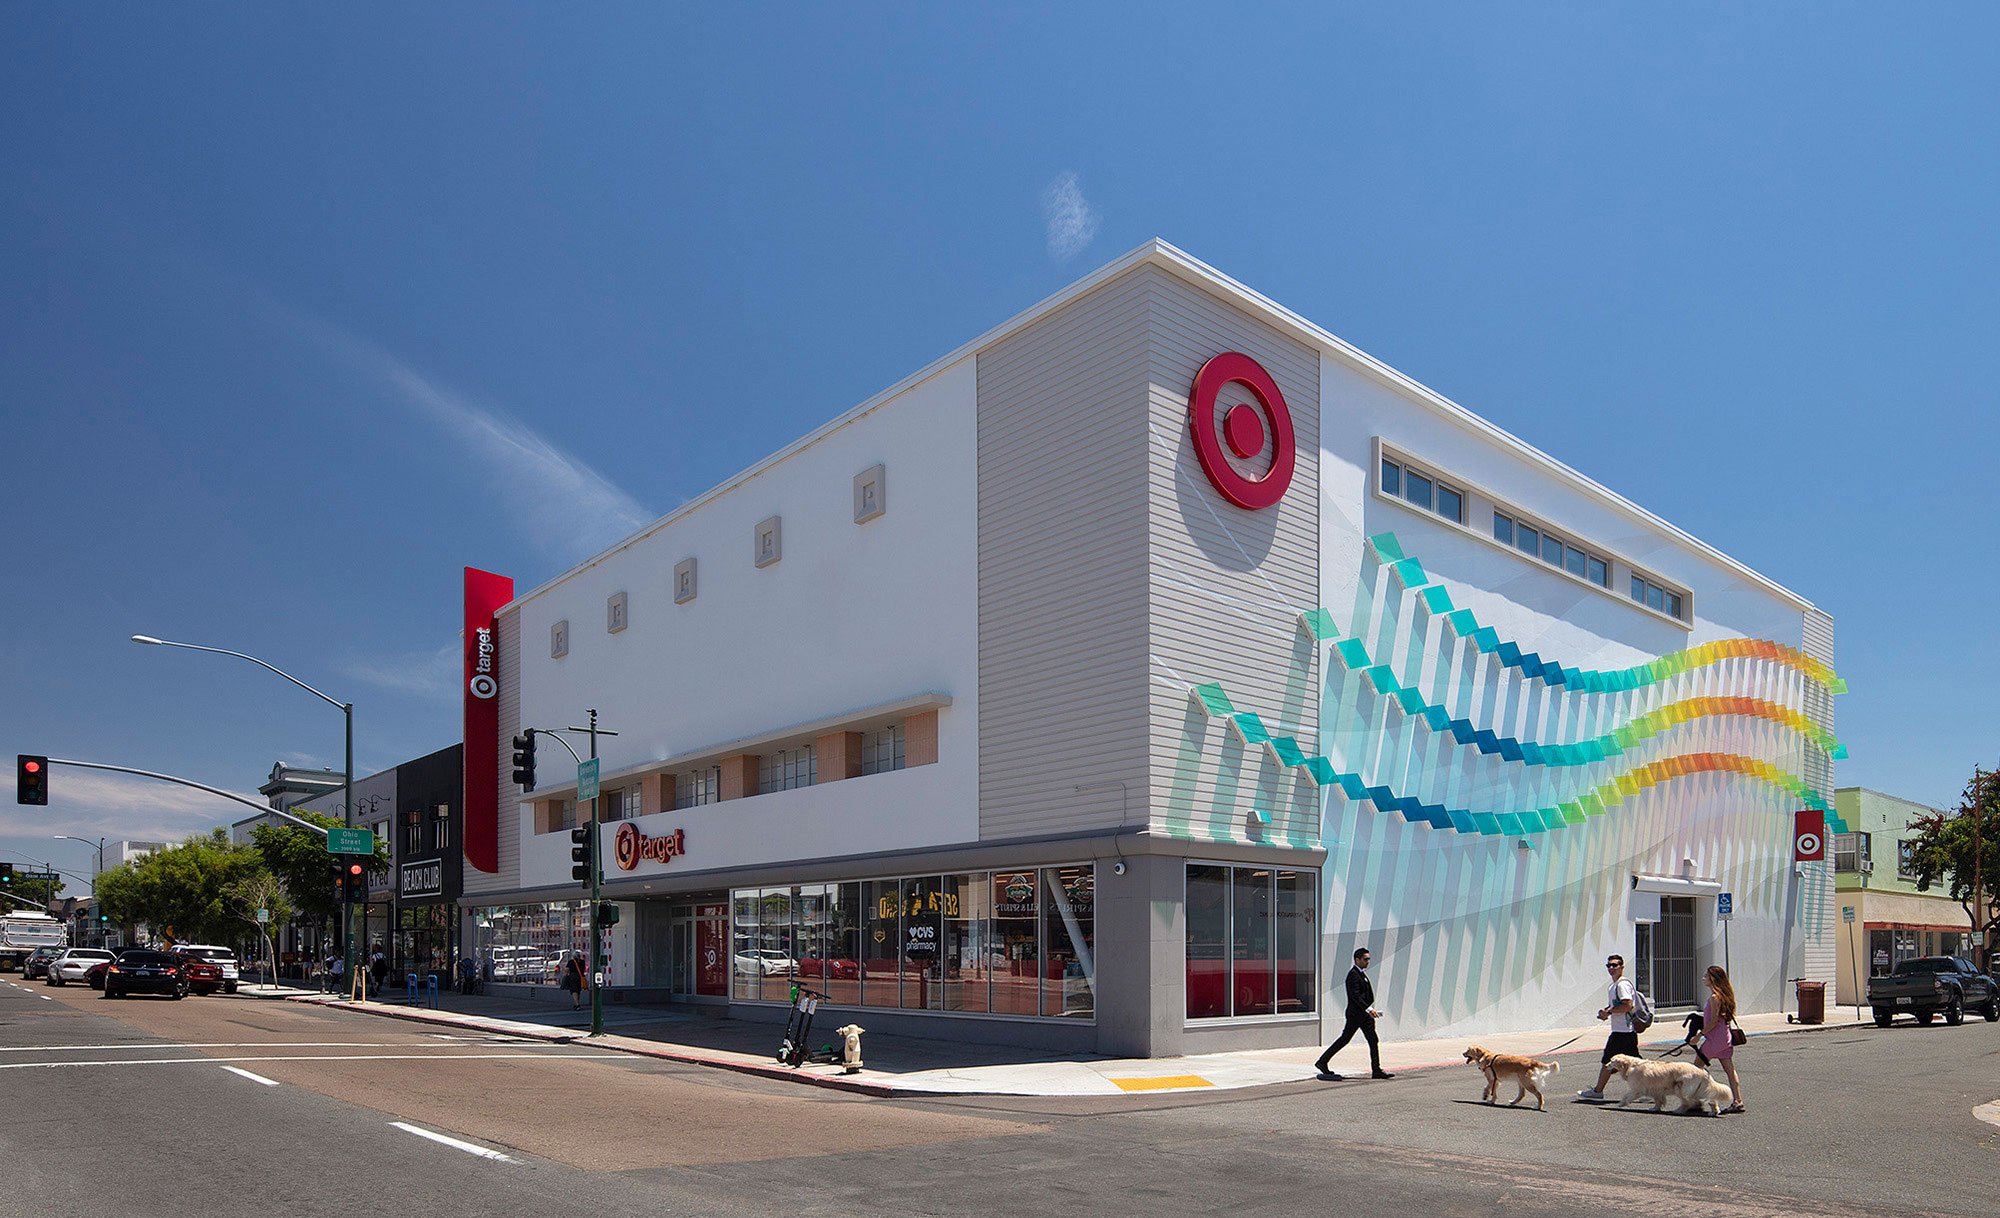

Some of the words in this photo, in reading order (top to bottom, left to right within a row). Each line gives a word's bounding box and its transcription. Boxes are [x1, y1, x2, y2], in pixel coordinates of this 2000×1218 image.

[476, 627, 494, 673] target
[638, 828, 685, 864] target
[404, 868, 422, 892] BEACH
[424, 865, 439, 890] CLUB
[917, 926, 934, 938] CVS
[906, 941, 937, 952] pharmacy
